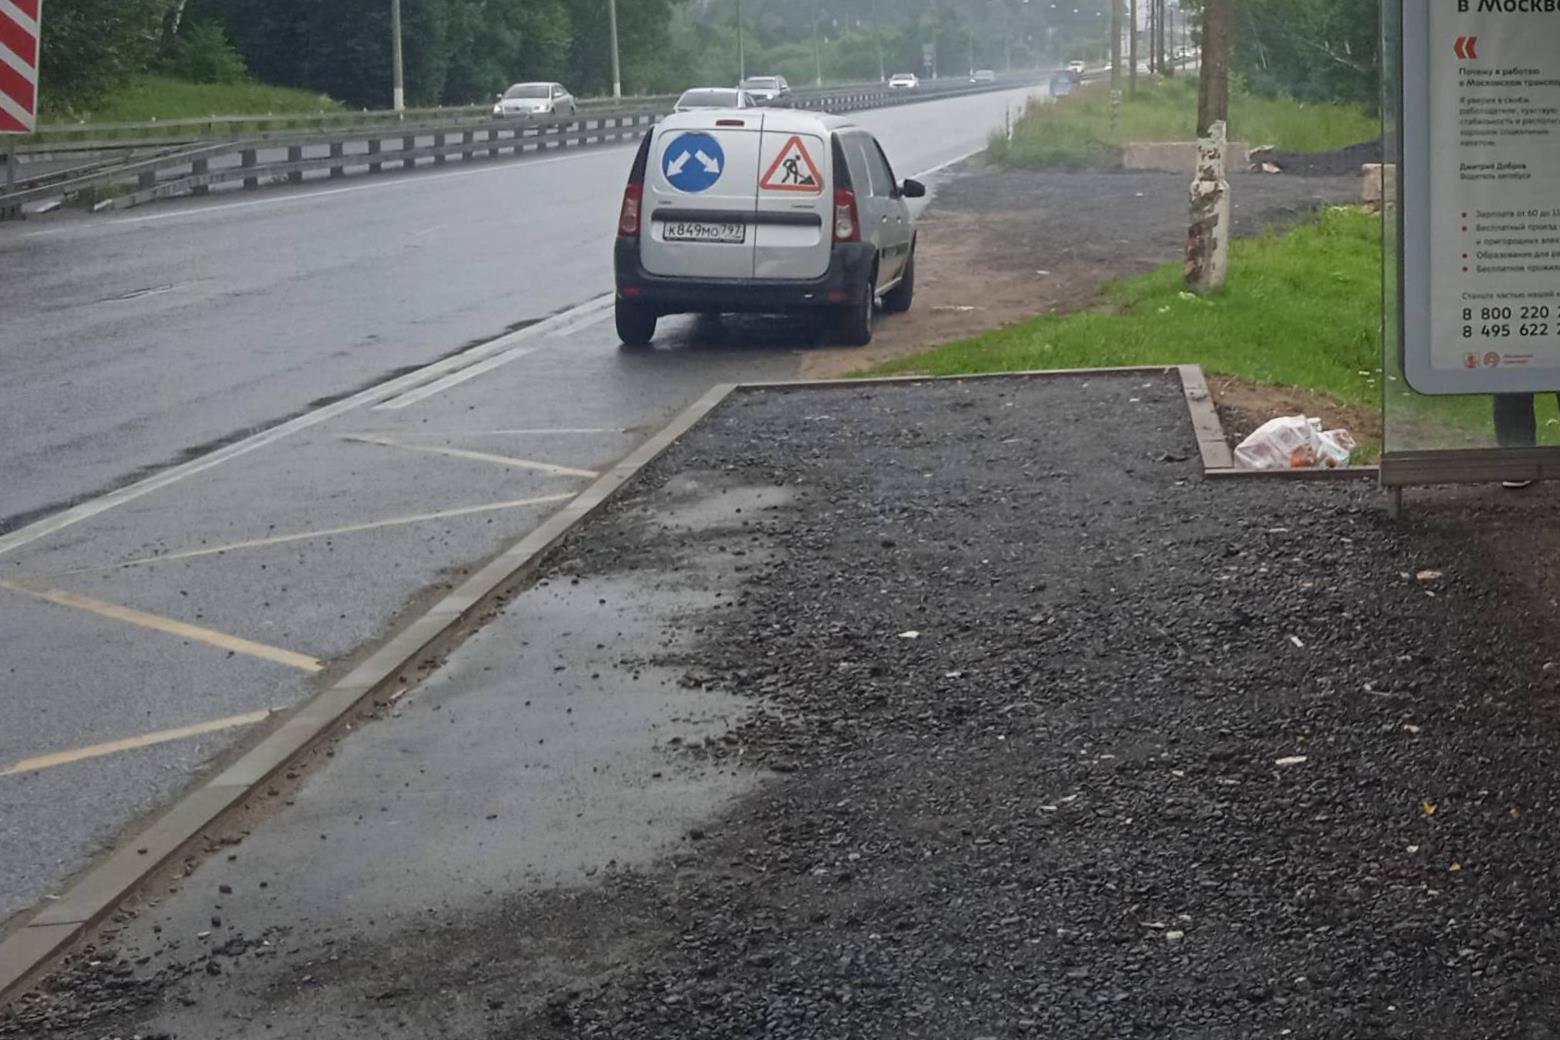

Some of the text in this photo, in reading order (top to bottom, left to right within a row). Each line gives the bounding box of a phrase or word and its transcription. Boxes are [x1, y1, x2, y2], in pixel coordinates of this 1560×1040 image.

[1462, 308, 1472, 320] 8
[1481, 306, 1512, 320] 800
[1520, 306, 1549, 319] 220
[1462, 325, 1472, 338] 8
[1481, 324, 1511, 337] 495
[1519, 323, 1548, 336] 622
